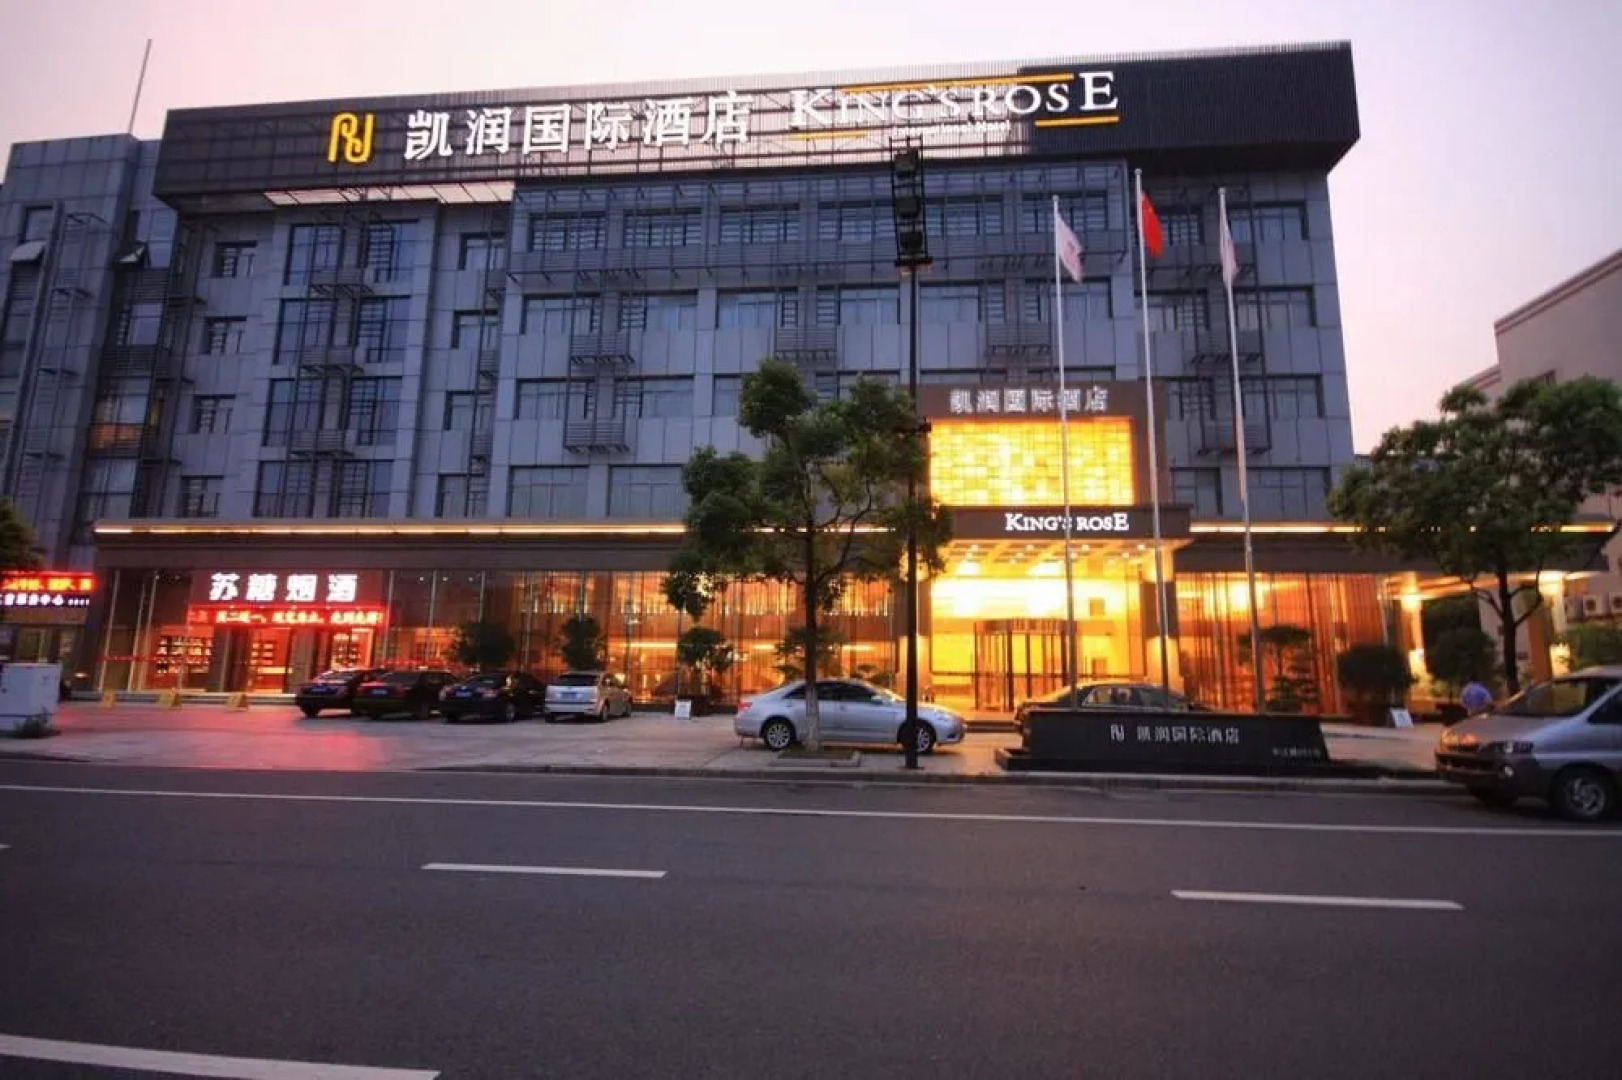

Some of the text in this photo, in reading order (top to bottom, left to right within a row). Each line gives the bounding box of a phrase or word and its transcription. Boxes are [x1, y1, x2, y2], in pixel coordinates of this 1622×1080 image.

[404, 91, 754, 160] 凯润国际酒店
